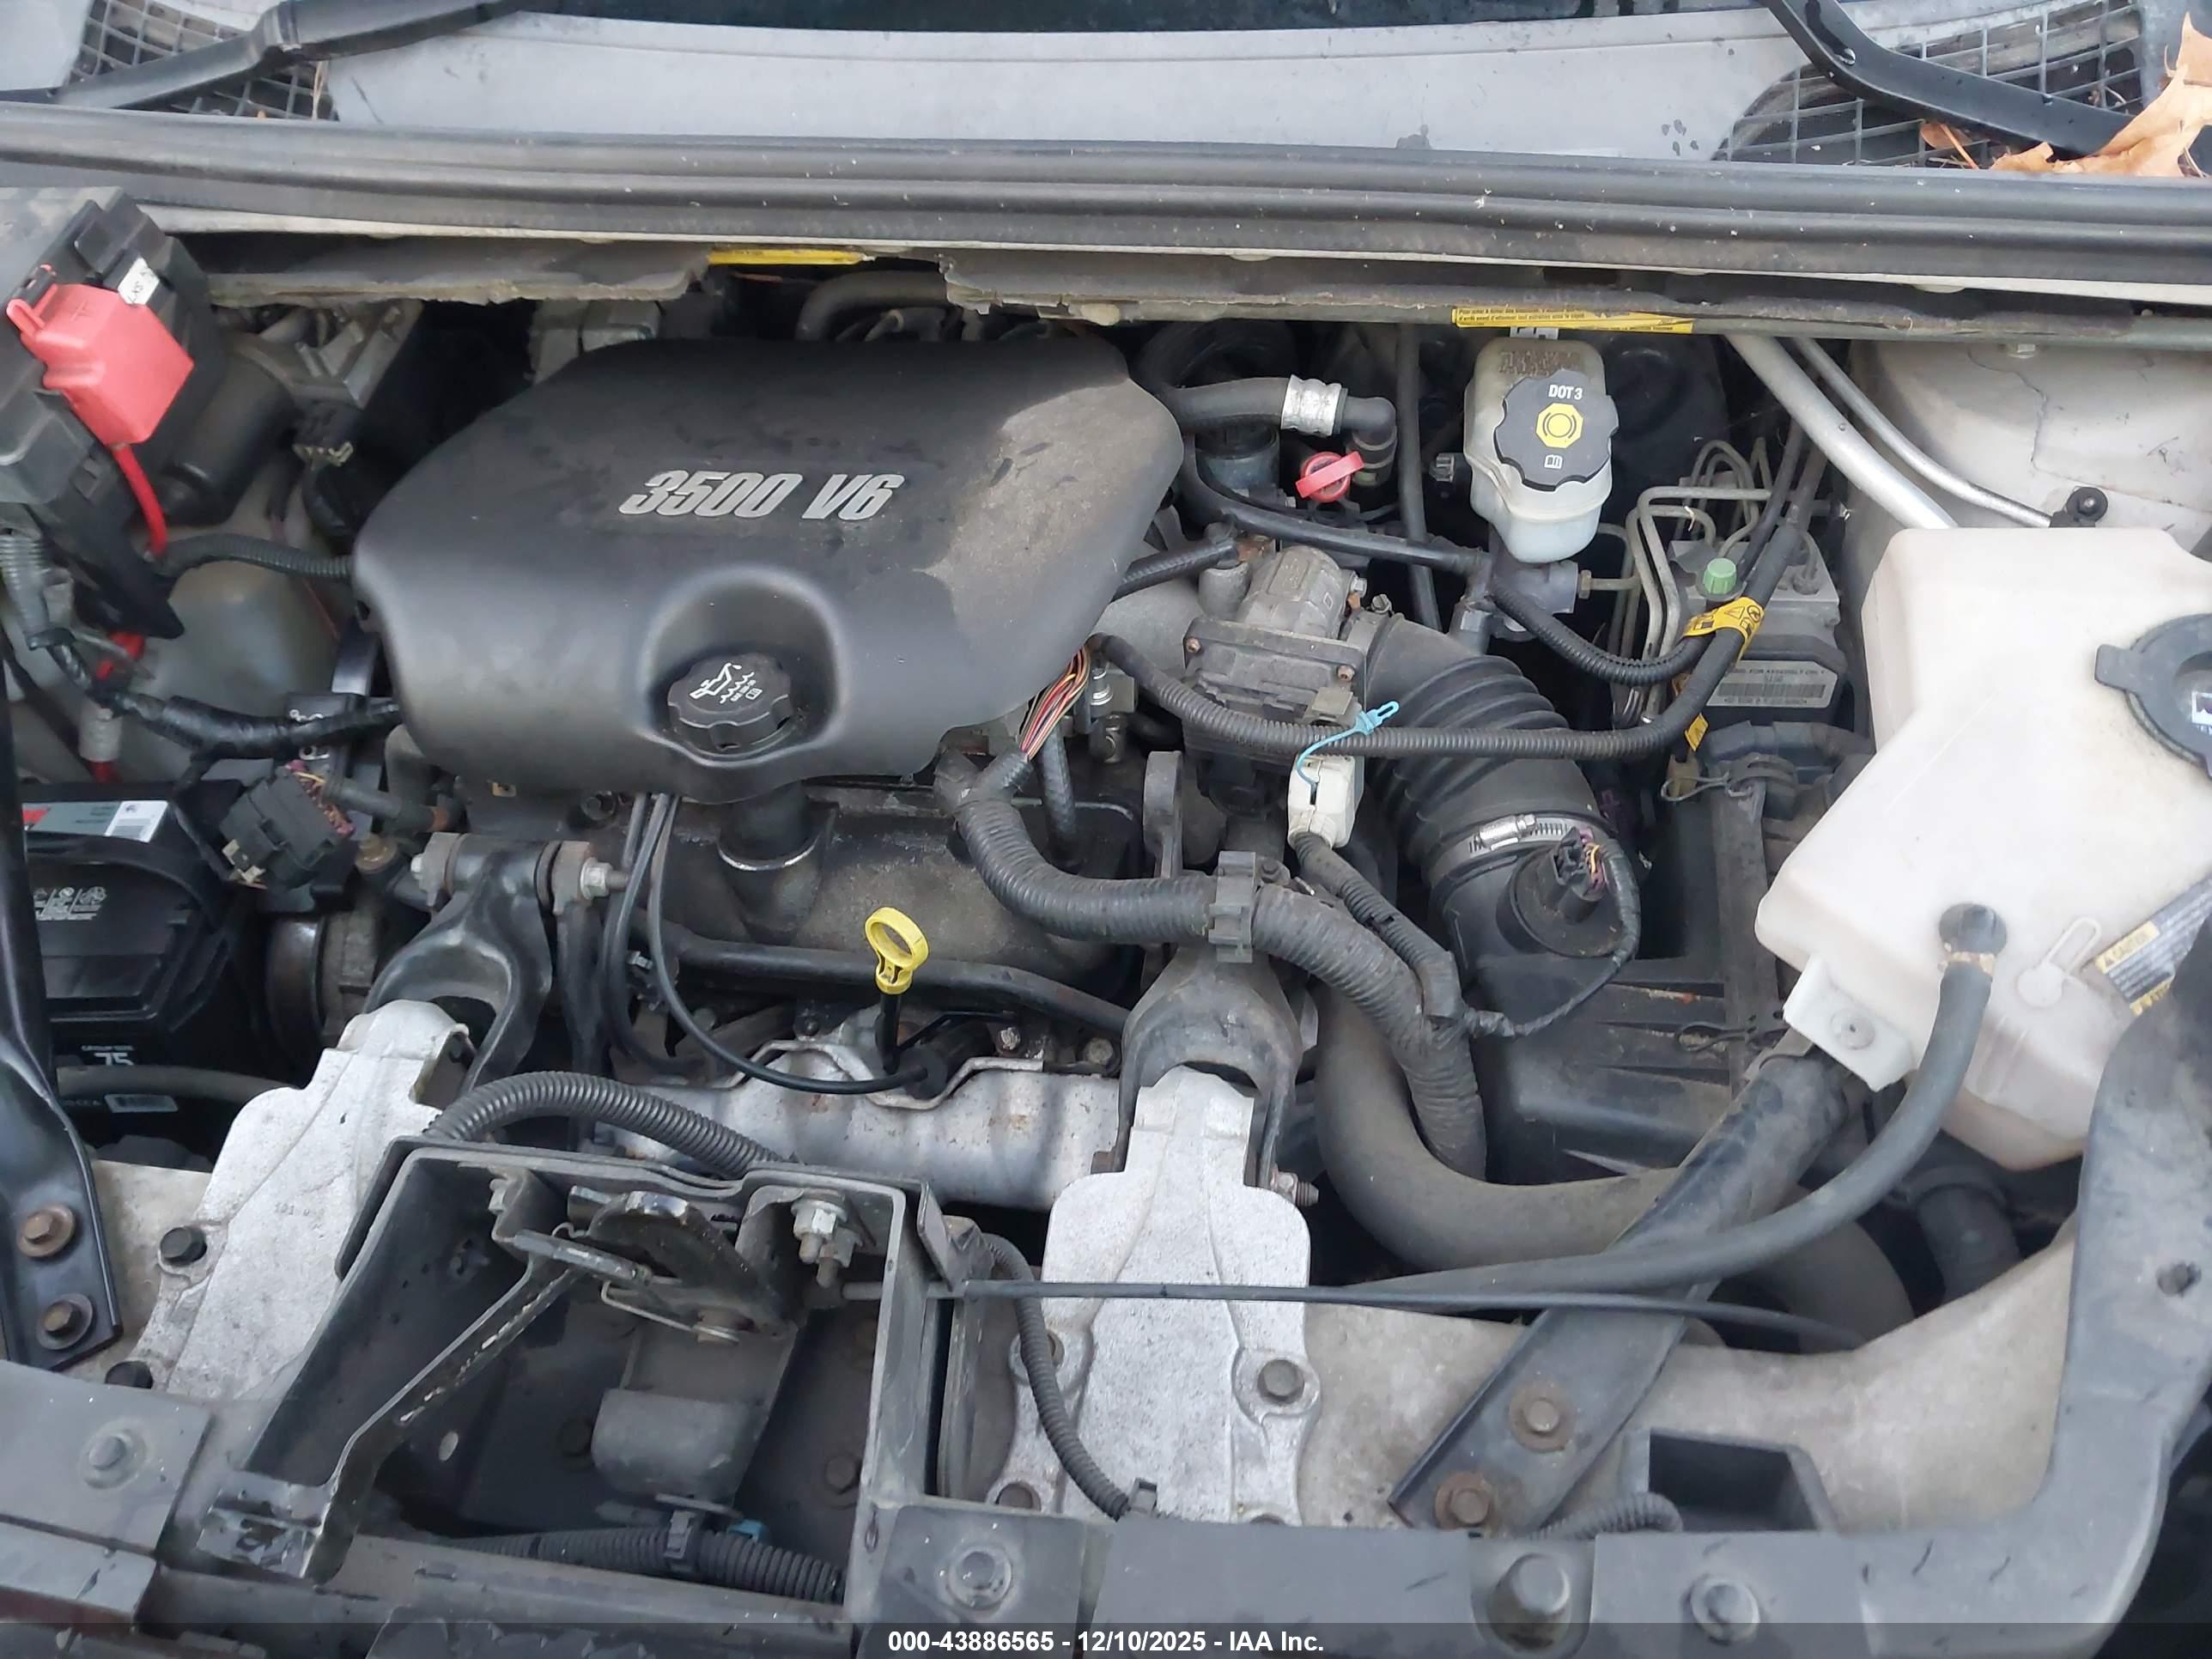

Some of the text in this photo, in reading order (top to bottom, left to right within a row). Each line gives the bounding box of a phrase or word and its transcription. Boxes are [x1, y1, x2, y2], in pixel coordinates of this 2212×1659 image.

[1548, 384, 1583, 400] DOT 3
[618, 470, 905, 520] 3500 V6
